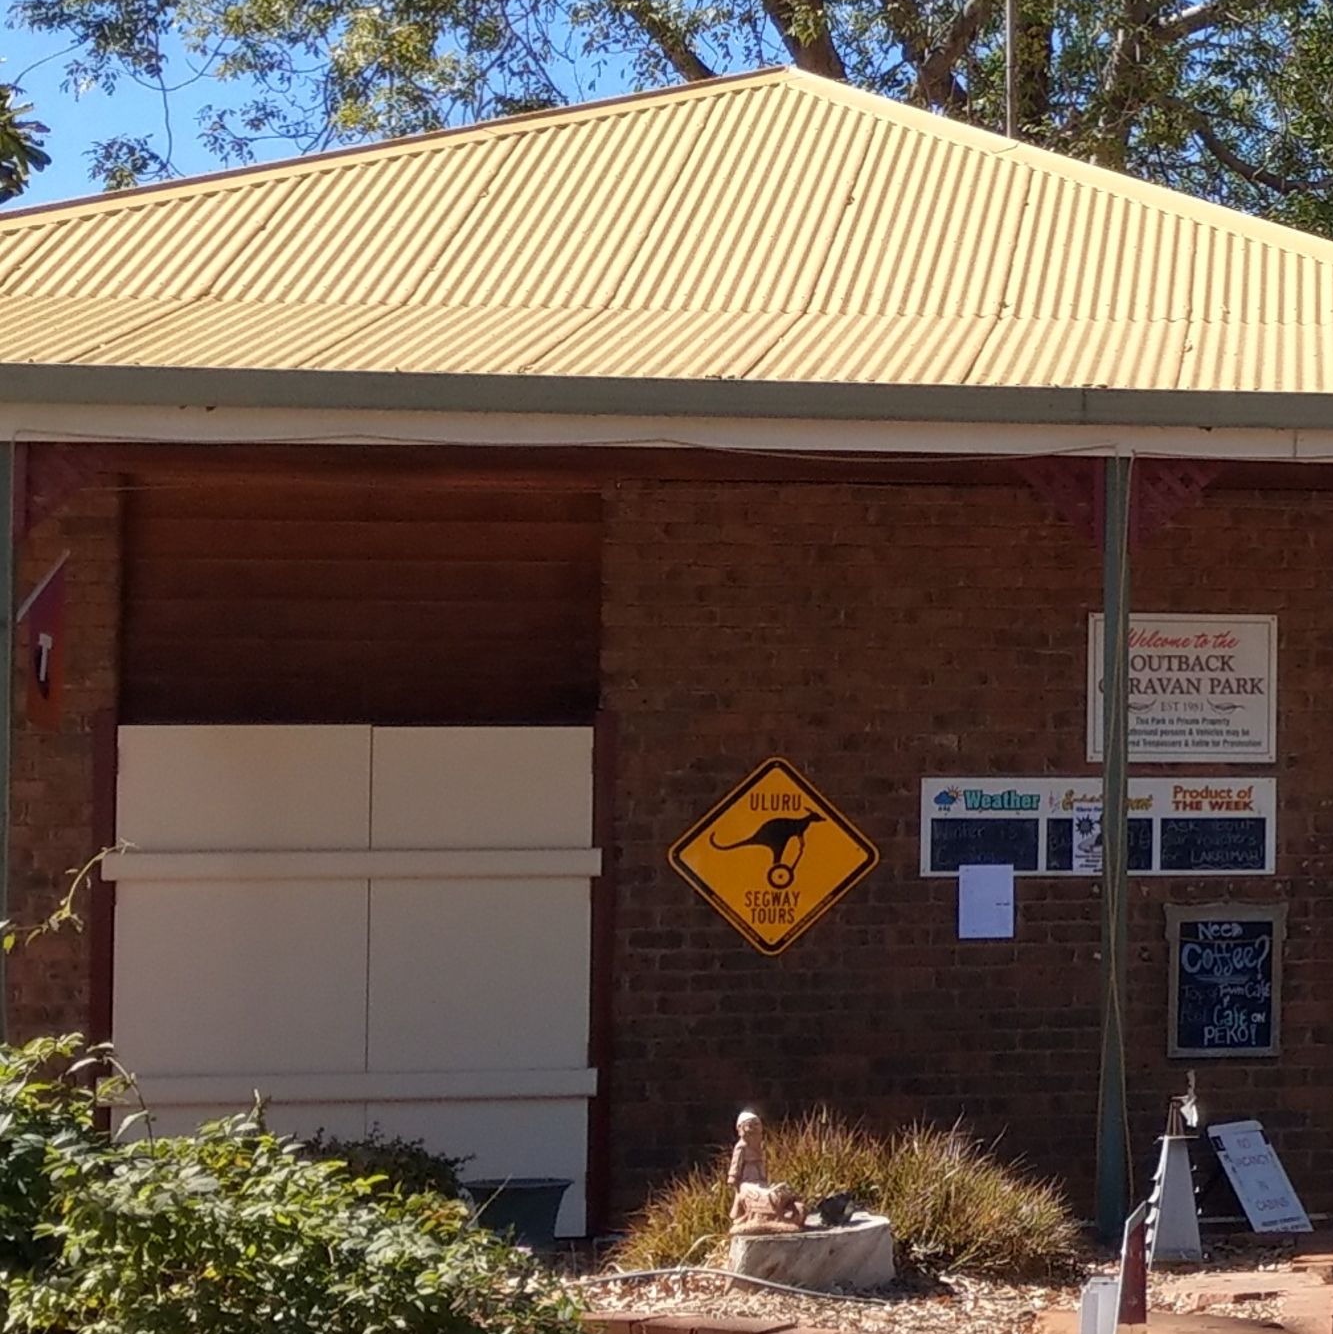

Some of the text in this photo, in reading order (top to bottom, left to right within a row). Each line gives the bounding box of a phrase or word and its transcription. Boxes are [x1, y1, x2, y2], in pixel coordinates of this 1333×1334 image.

[1128, 627, 1239, 650] Welcome to the
[1130, 654, 1235, 672] OUTBACK
[1099, 677, 1264, 695] RAVAN PARK
[1161, 702, 1179, 712] EST
[963, 789, 1040, 810] Weather
[1172, 785, 1255, 799] Product of
[750, 793, 802, 812] ULURU
[1172, 800, 1254, 811] THE WEEK
[744, 890, 801, 907] SEGWAY
[751, 908, 795, 924] TOURS
[1181, 935, 1270, 980] Coffee?
[1204, 1024, 1258, 1046] PEKO!
